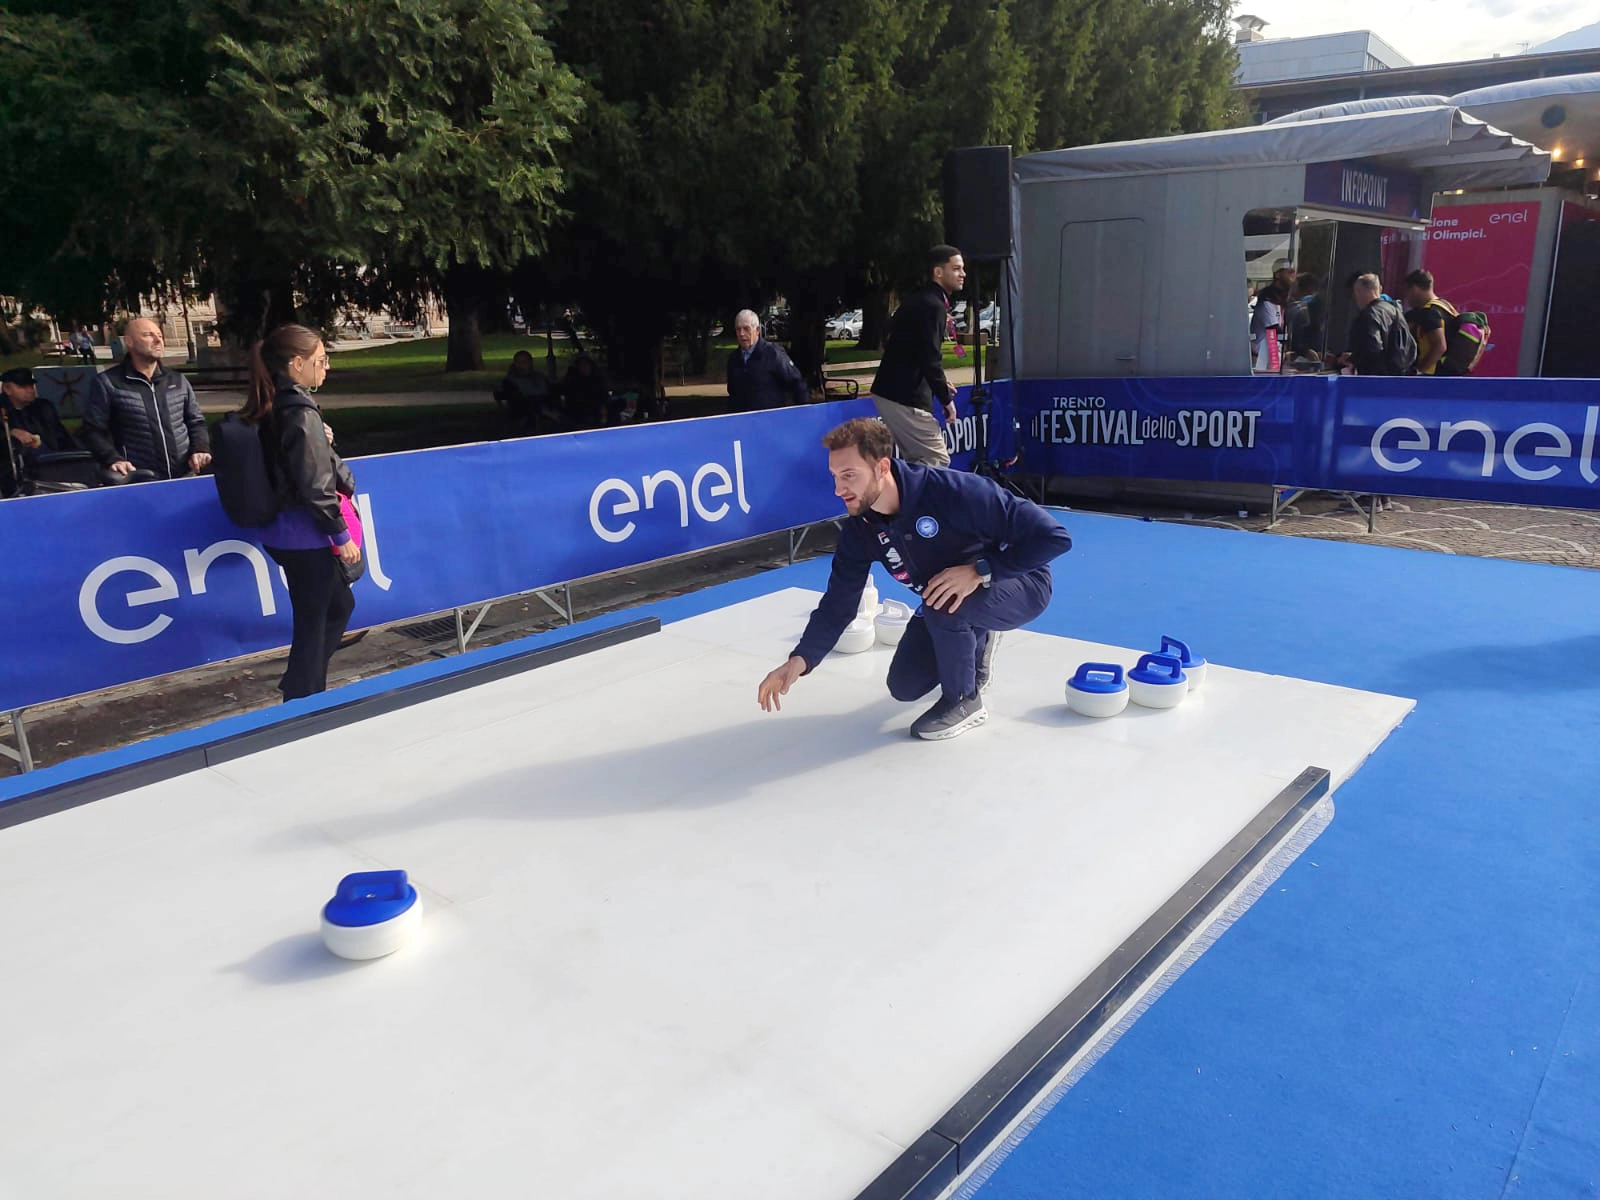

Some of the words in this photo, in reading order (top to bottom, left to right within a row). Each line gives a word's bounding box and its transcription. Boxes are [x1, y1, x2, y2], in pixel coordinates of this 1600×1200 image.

[1341, 168, 1389, 209] INFOPOINT
[1432, 228, 1487, 241] Olimpici.
[1488, 209, 1528, 225] enel
[1053, 396, 1106, 409] TRENTO
[1039, 410, 1144, 446] FESTIVAL
[1142, 415, 1176, 440] dello
[1176, 410, 1262, 449] SPORT
[1370, 405, 1600, 485] enel
[589, 440, 751, 543] enel
[78, 493, 393, 645] enl
